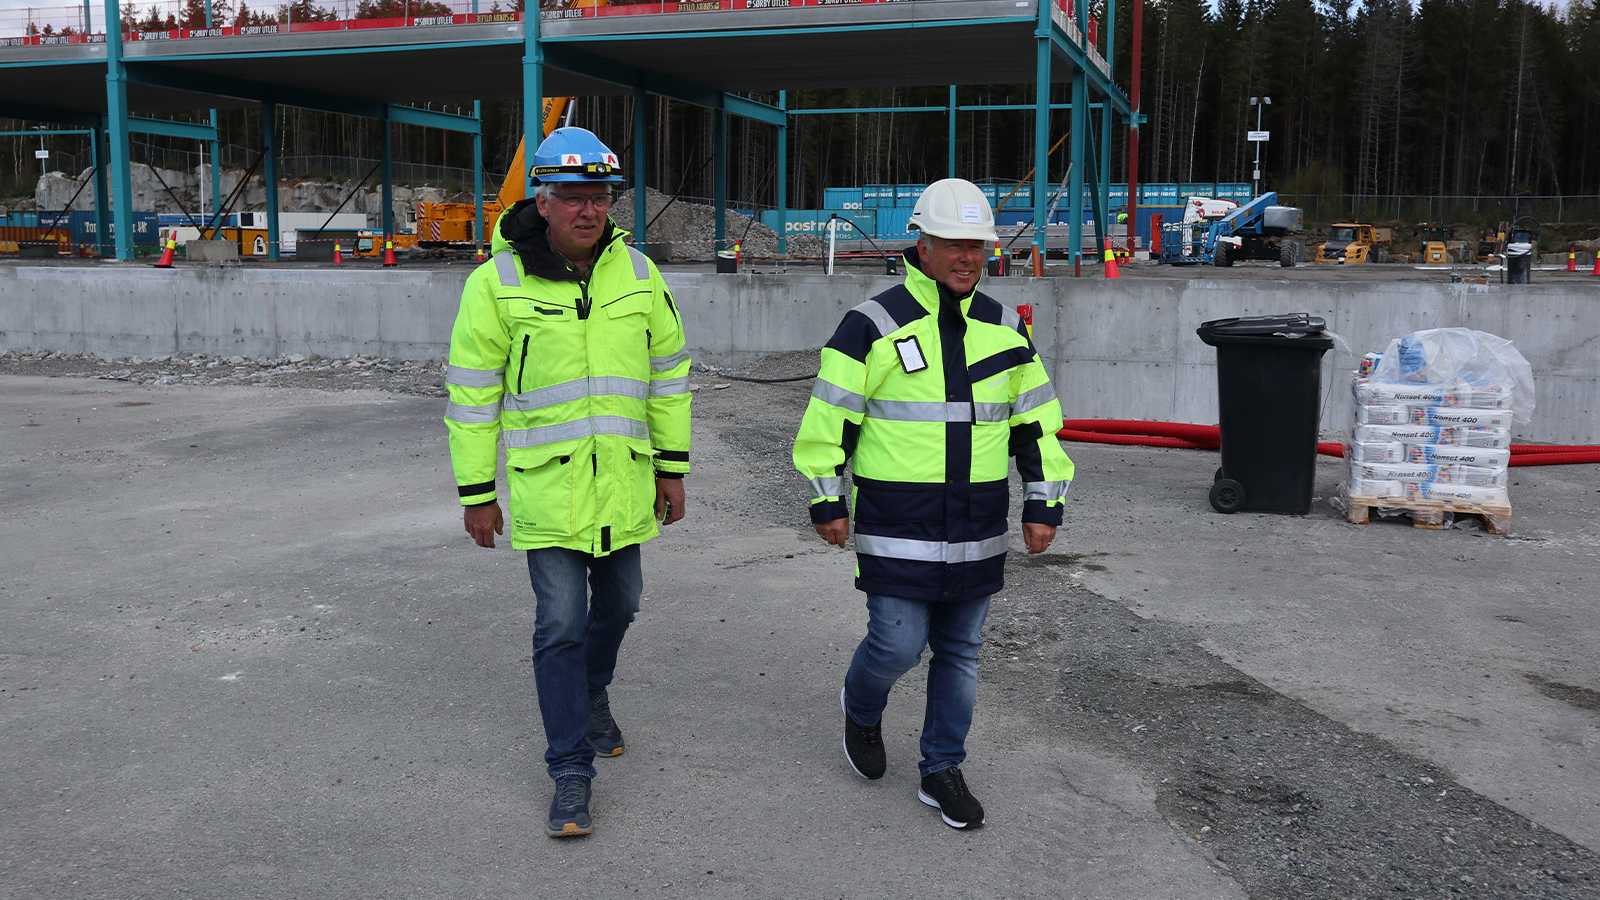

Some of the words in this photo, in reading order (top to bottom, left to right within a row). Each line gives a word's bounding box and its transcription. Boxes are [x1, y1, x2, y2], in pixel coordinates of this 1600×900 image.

[545, 10, 563, 19] SØRBY
[420, 17, 436, 26] SØRBY
[1433, 414, 1460, 422] Nonset
[1430, 453, 1458, 461] Nonset
